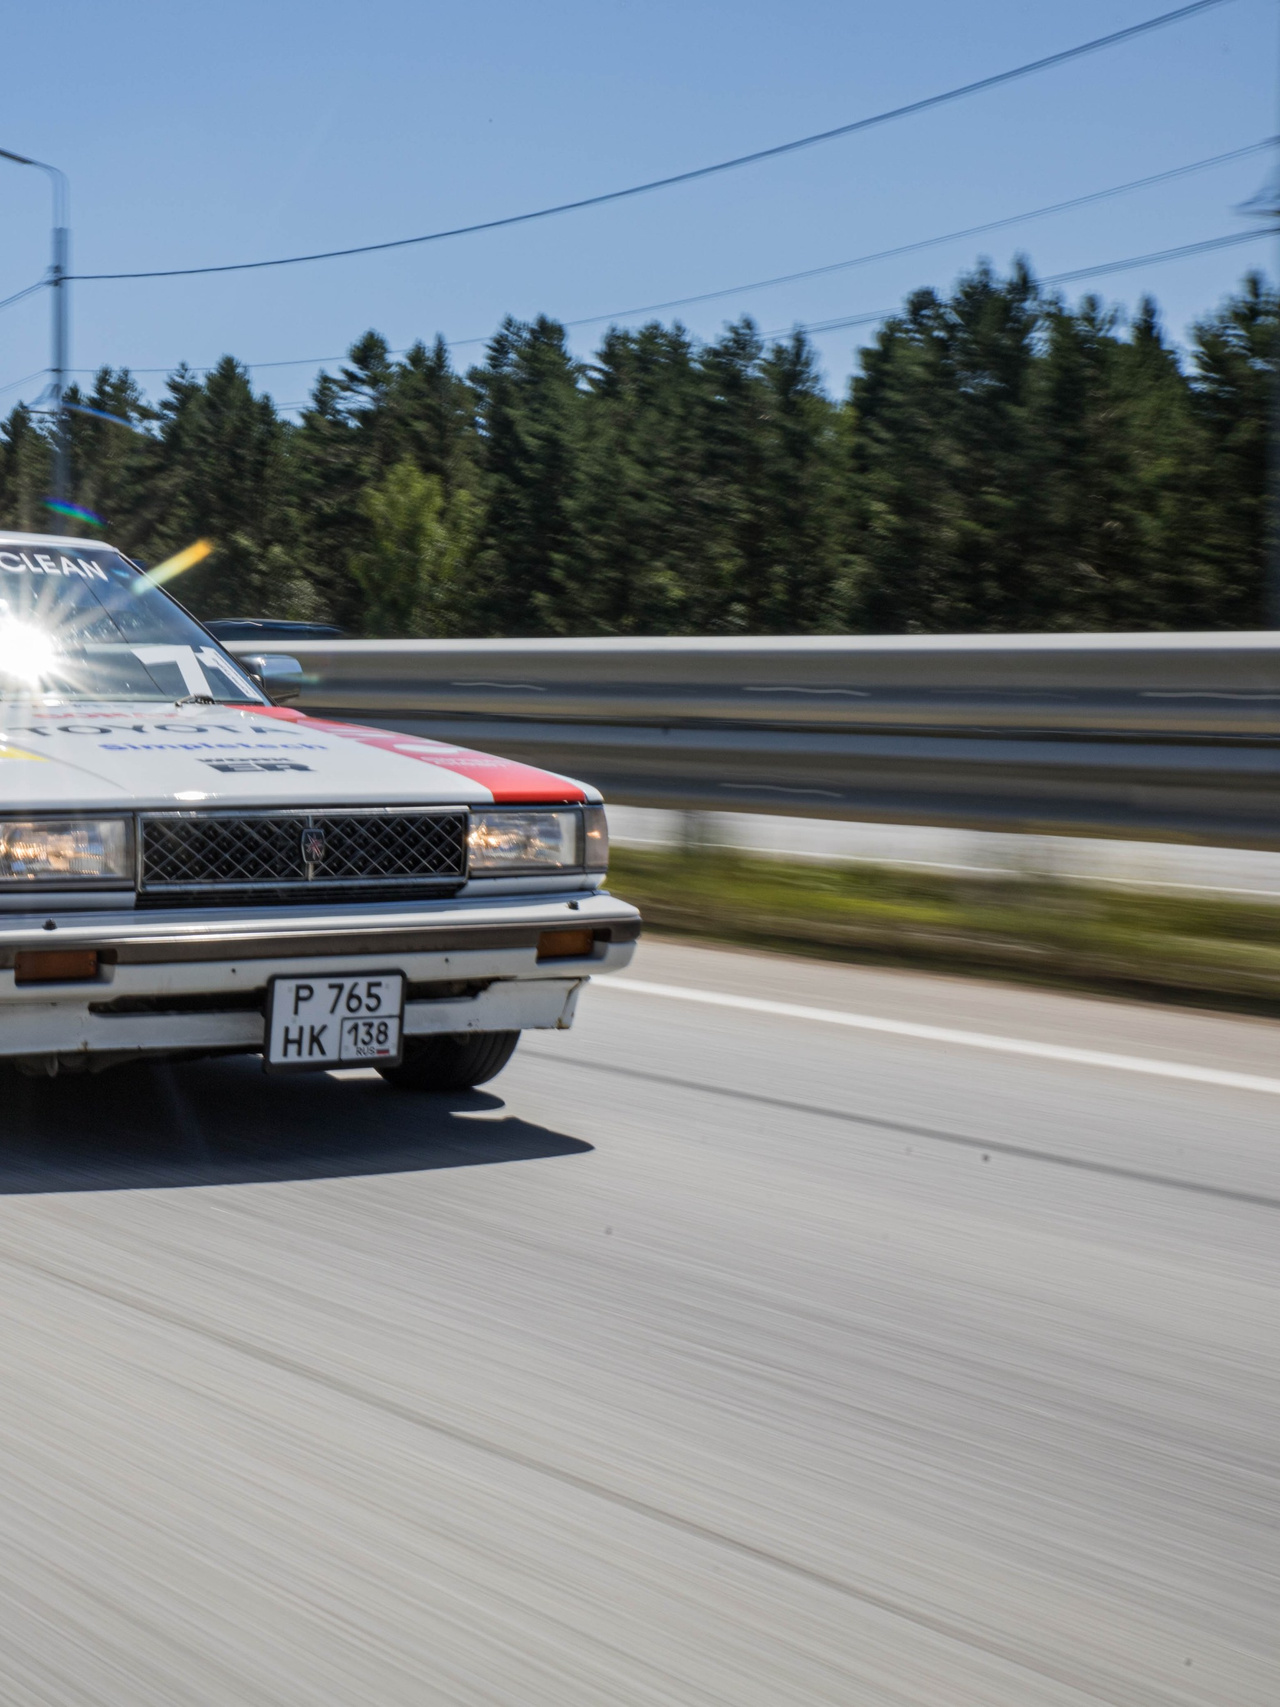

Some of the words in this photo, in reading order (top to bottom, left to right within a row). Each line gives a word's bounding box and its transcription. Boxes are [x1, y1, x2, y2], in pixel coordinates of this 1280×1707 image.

[7, 723, 303, 737] TOYOTA
[293, 984, 314, 1016] P
[328, 981, 382, 1014] 765
[282, 1024, 328, 1058] HK
[347, 1021, 389, 1047] 138
[355, 1046, 376, 1056] RUS
